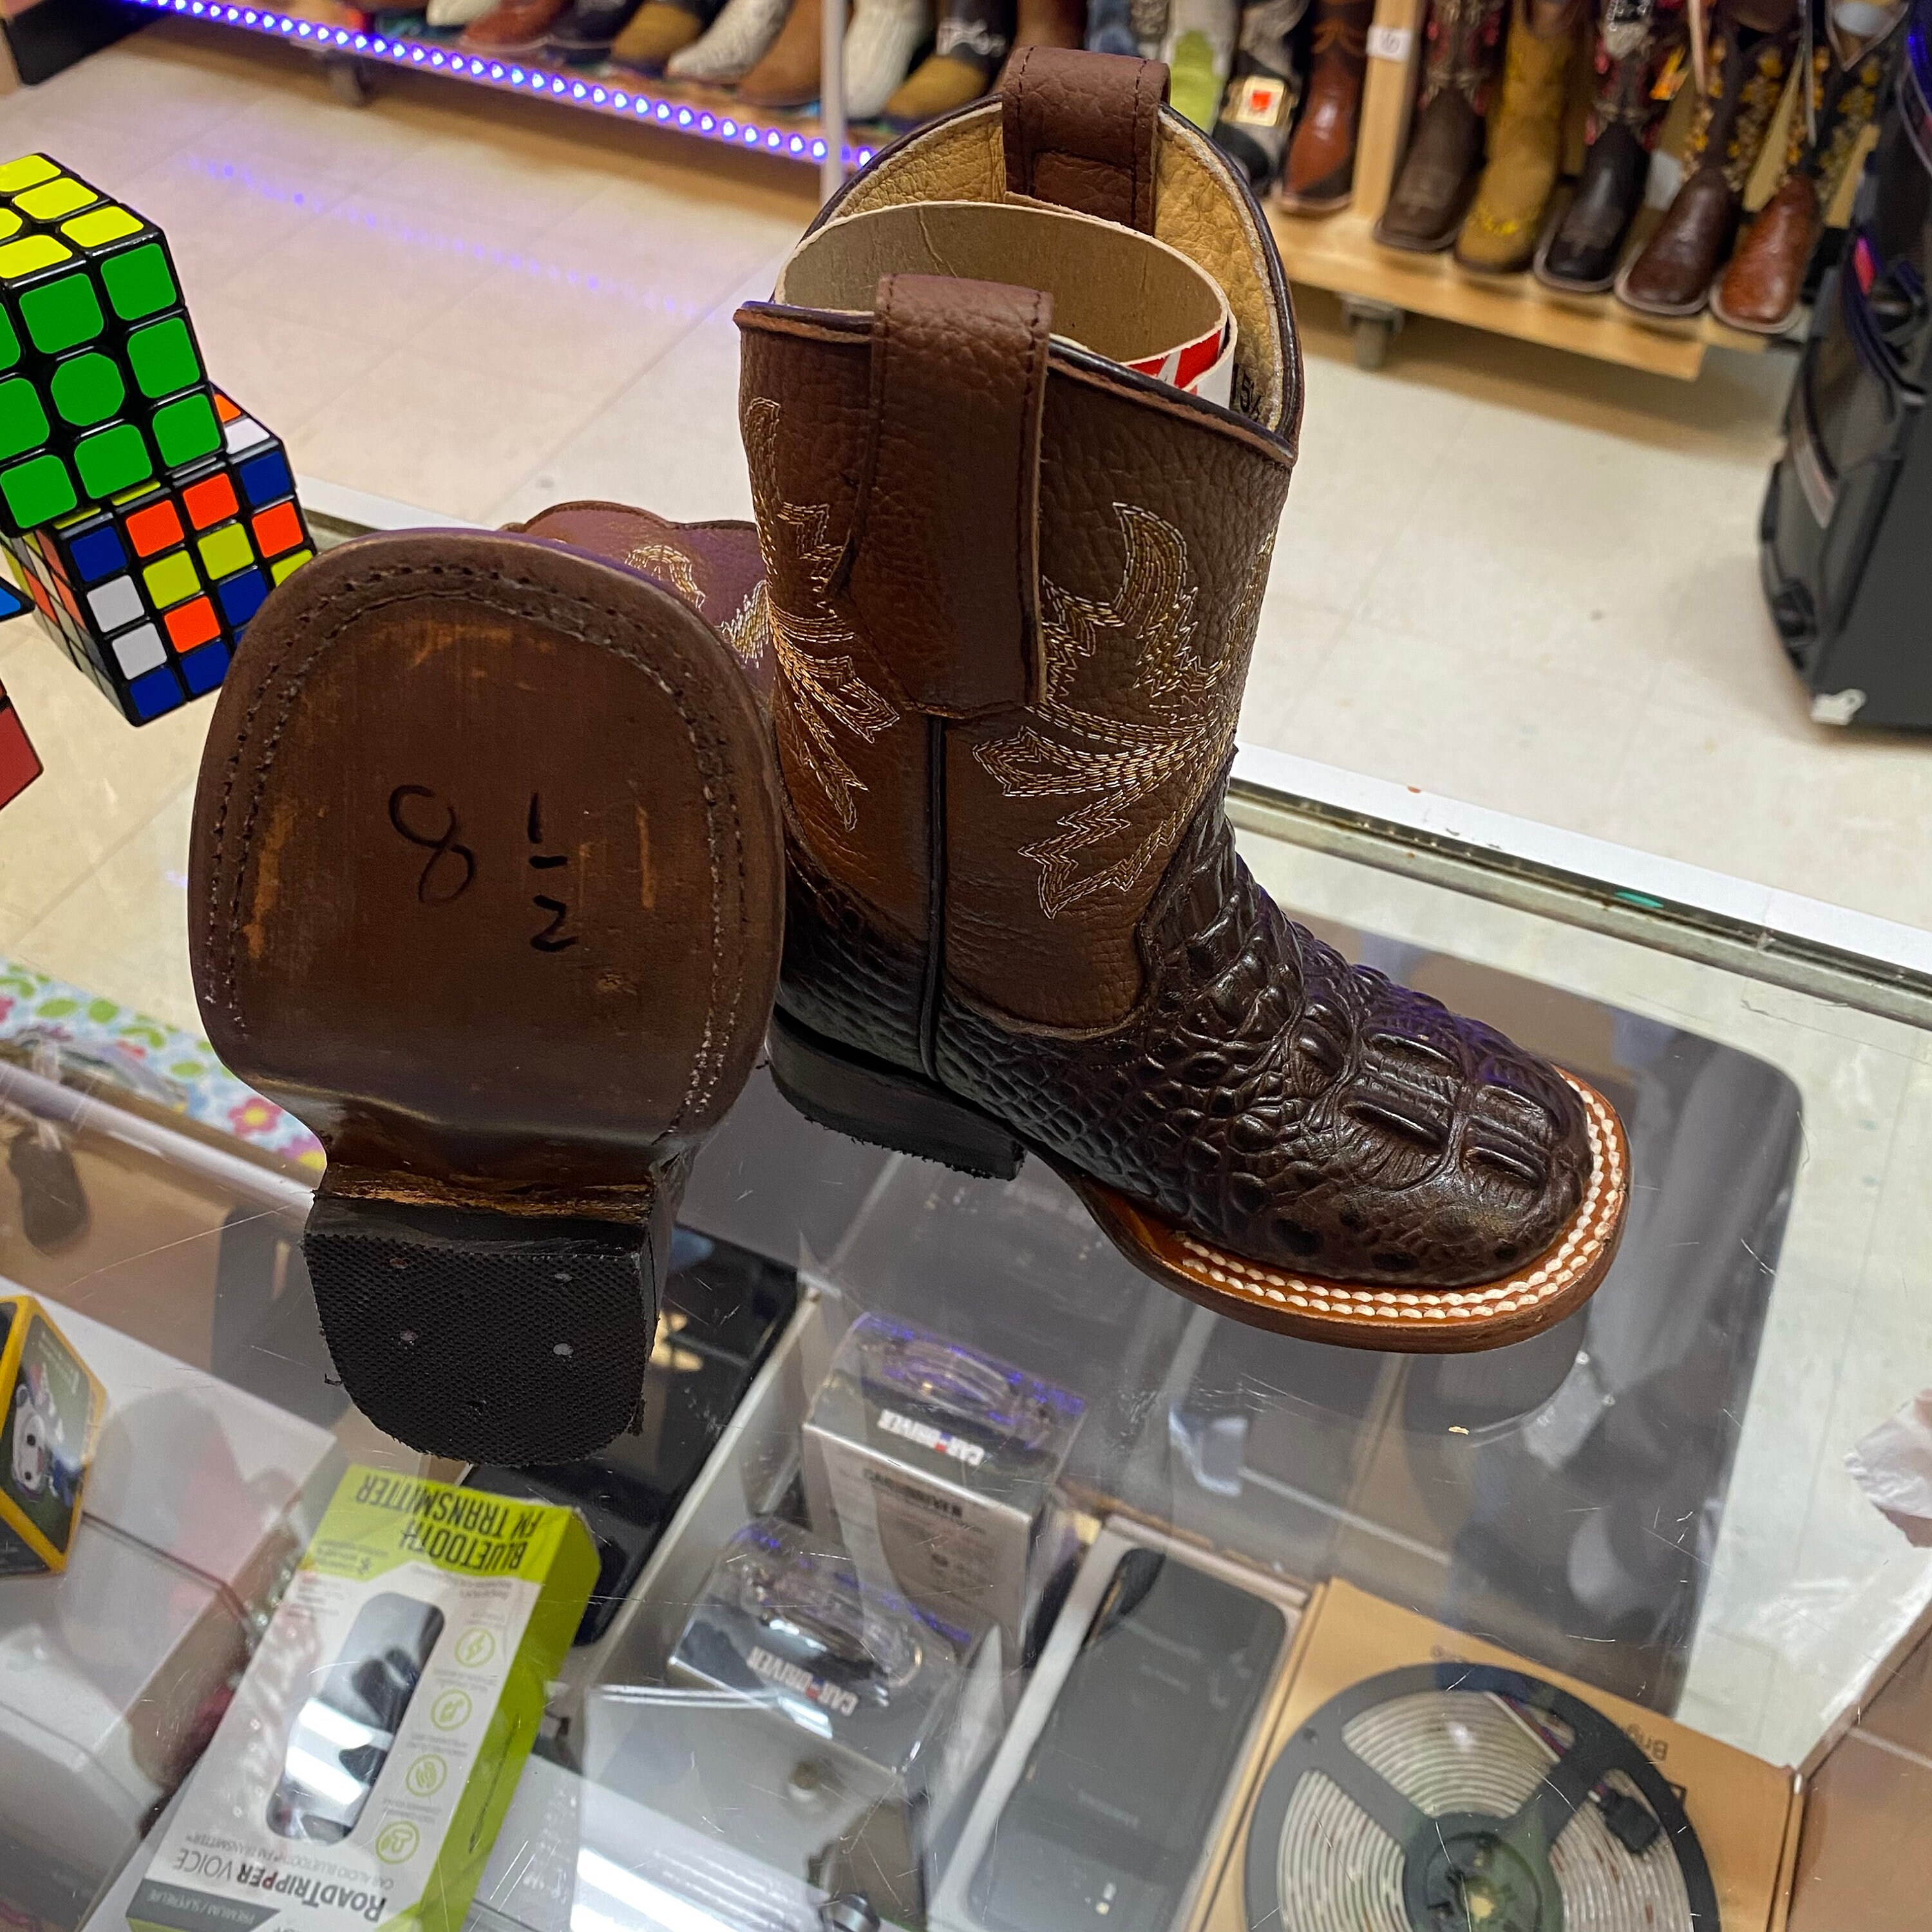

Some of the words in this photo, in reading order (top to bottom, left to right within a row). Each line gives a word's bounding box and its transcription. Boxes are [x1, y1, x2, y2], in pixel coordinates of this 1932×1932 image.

[388, 784, 475, 904] 8
[355, 1473, 510, 1539] TRANSMITTER
[509, 1510, 544, 1540] FM
[399, 1520, 528, 1570] BLUETOOTH
[172, 1847, 233, 1881] VOICE
